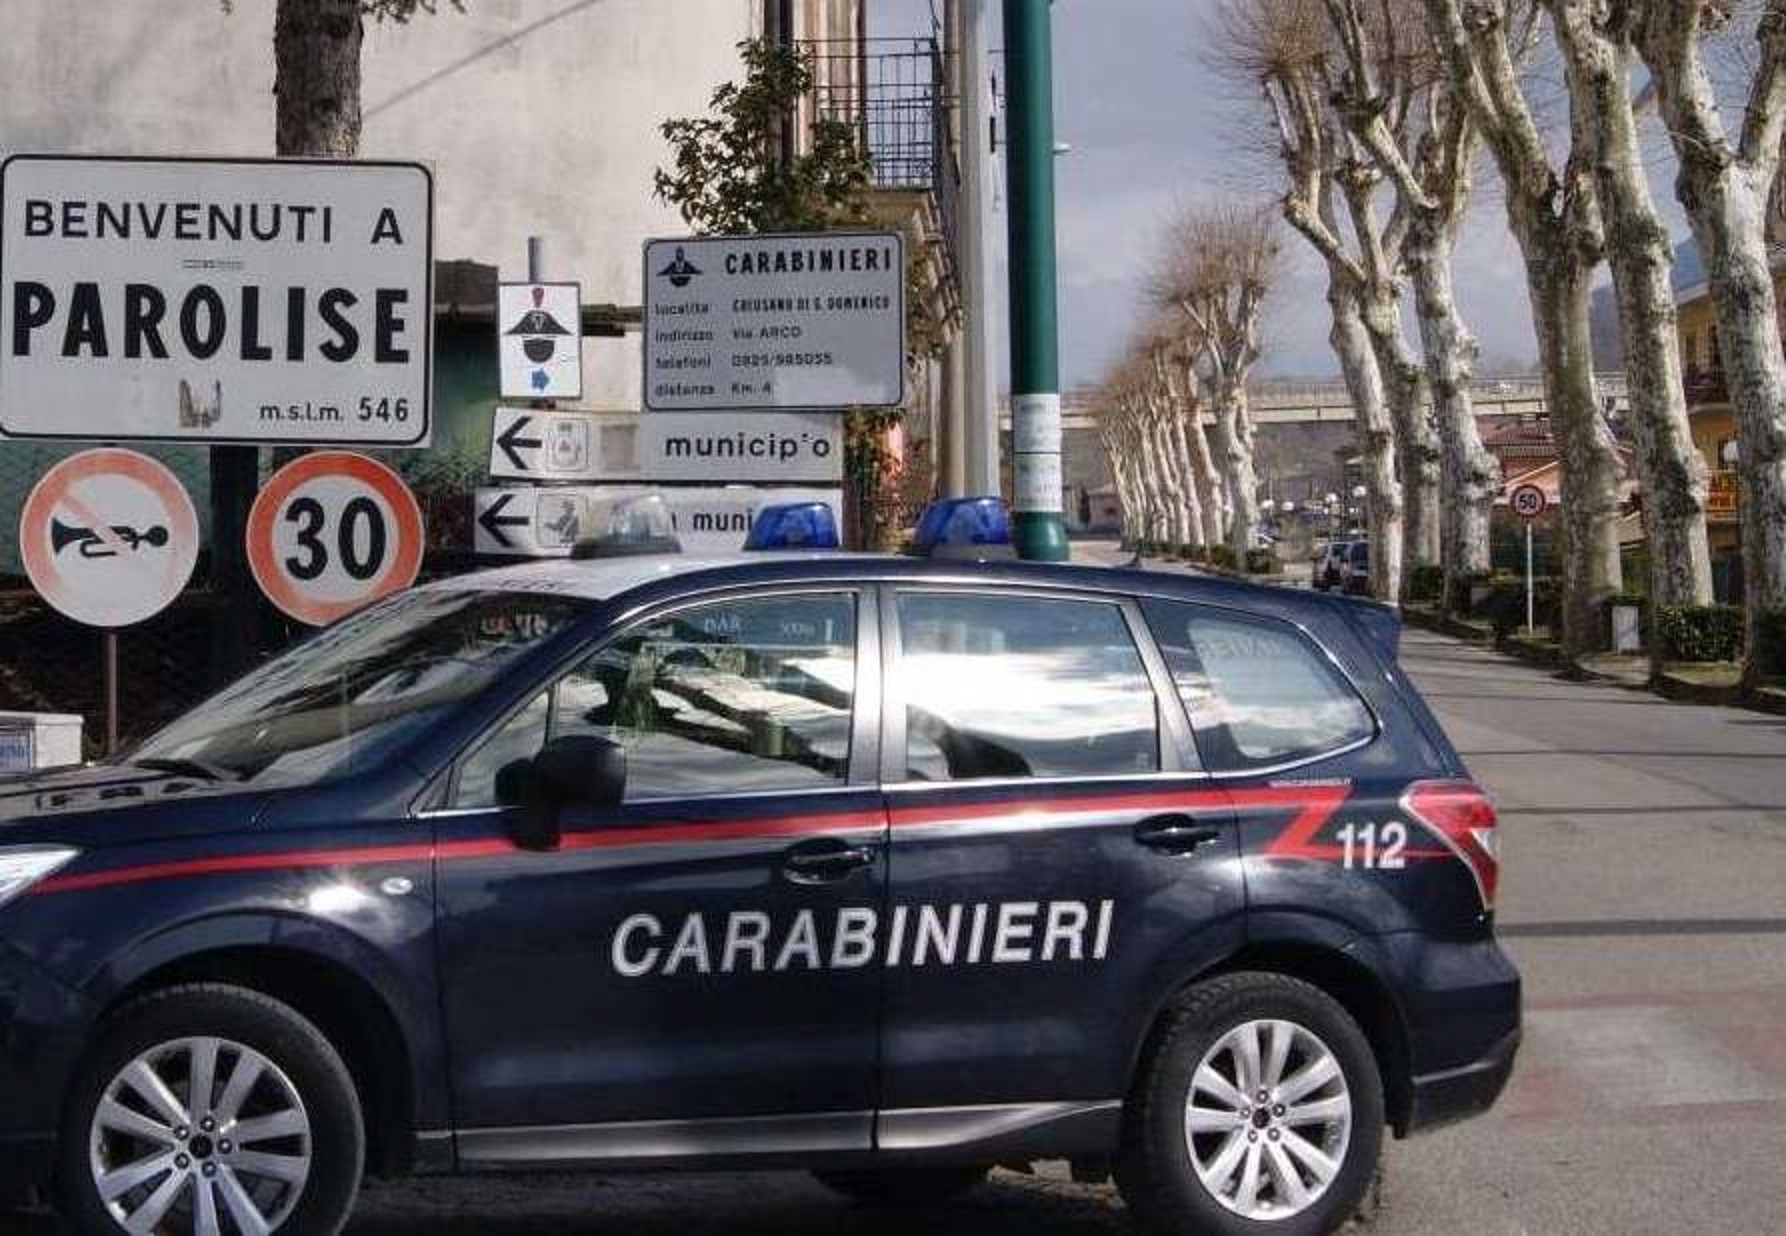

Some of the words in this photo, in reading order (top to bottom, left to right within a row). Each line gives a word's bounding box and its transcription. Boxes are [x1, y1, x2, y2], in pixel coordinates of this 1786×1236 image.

[24, 200, 332, 243] BENVENUTI
[371, 208, 403, 244] A
[726, 248, 891, 274] CARABINIERI
[12, 281, 410, 365] PAROLISE
[760, 325, 802, 338] ARCO
[260, 402, 344, 422] m.s.l.m.
[358, 397, 408, 422] 546
[1519, 493, 1537, 510] 50
[285, 497, 387, 580] 30
[1336, 821, 1407, 870] 112
[611, 899, 1114, 977] CARABINIERI
